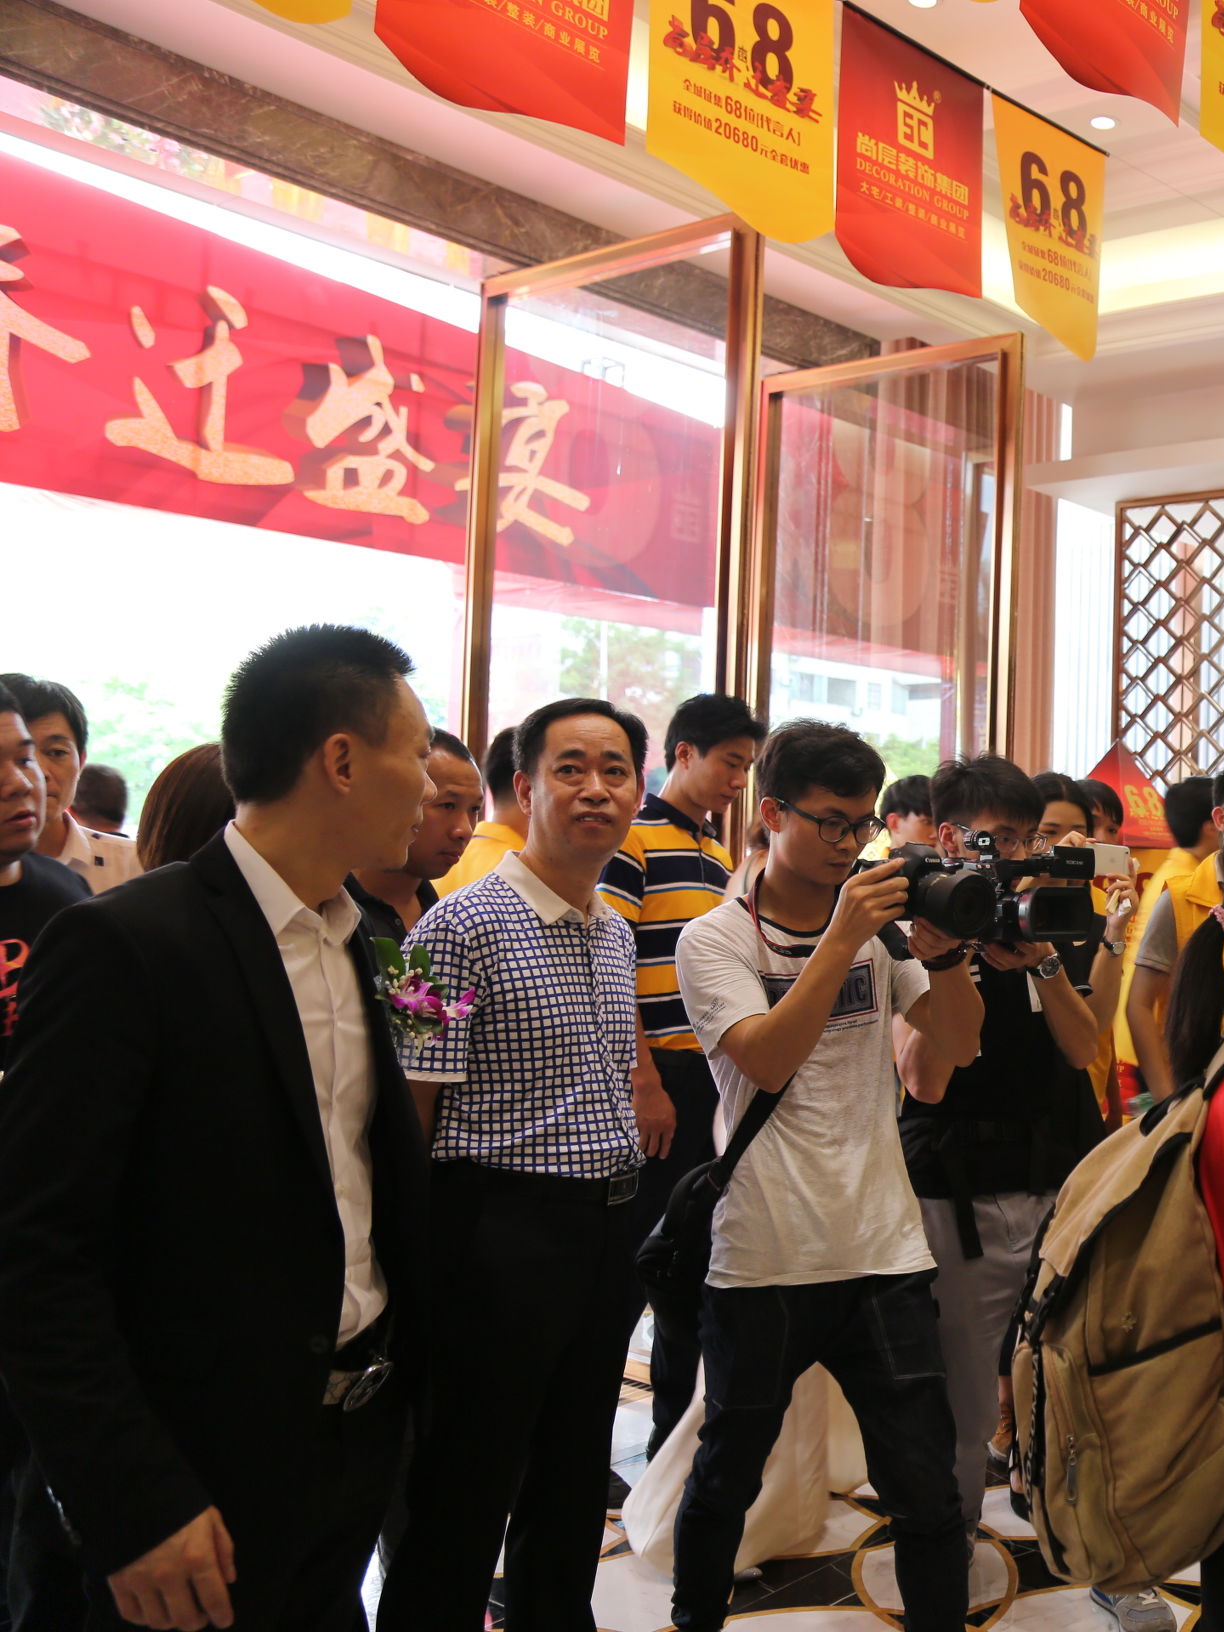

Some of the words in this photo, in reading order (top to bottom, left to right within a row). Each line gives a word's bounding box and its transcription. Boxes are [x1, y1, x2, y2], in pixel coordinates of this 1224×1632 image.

[550, 1, 609, 40] GROUP
[856, 131, 969, 206] 尚层装饰集团
[856, 158, 930, 201] DECORATION
[934, 195, 969, 220] GROUP
